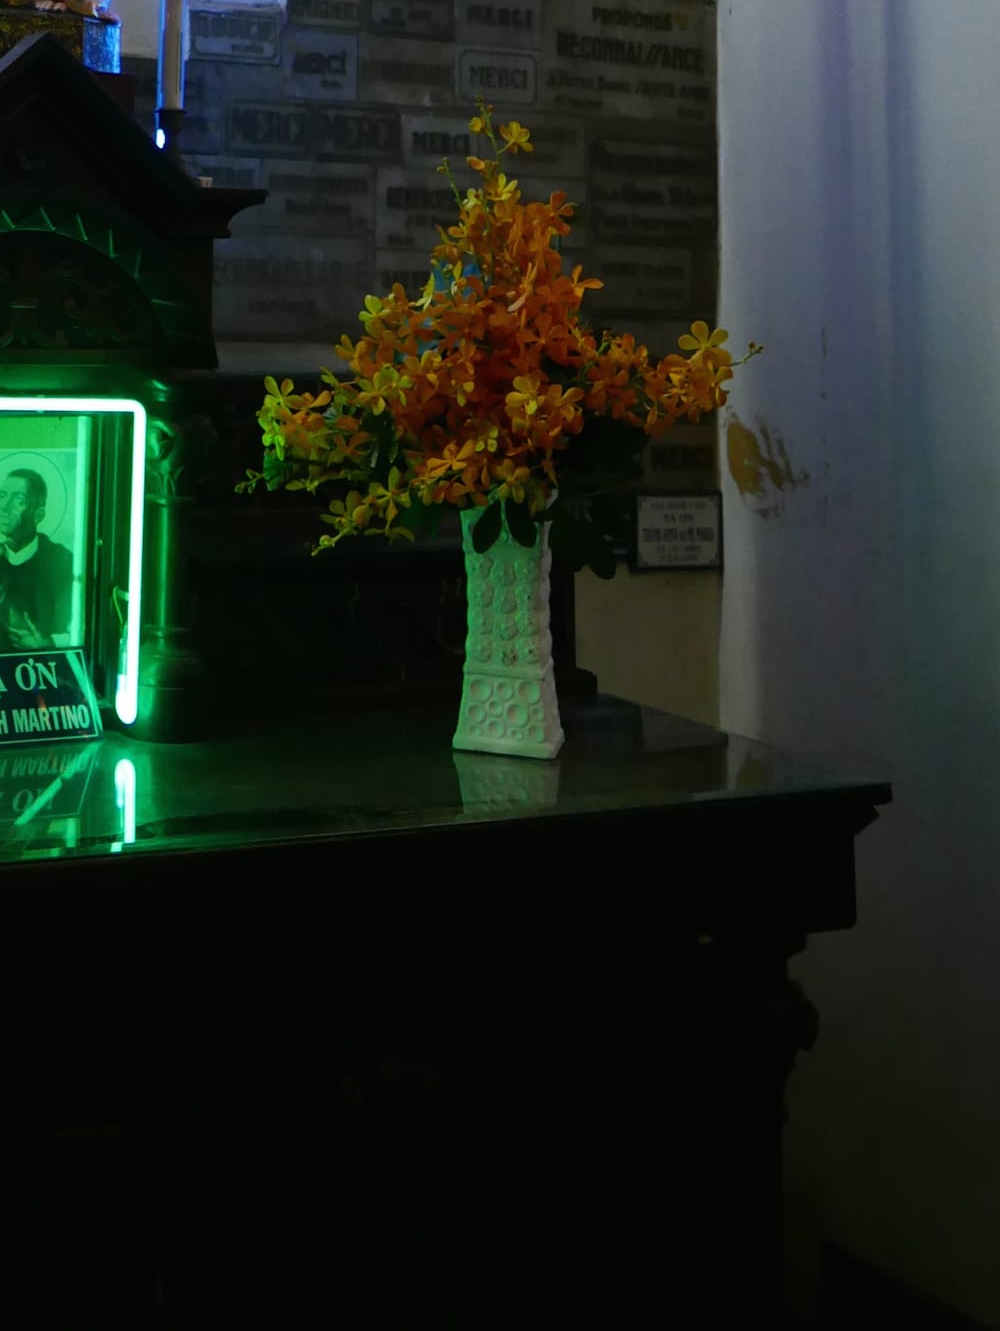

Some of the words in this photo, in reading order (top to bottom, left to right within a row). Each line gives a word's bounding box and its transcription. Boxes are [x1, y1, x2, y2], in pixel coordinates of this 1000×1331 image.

[466, 4, 534, 30] MERCI
[469, 65, 528, 91] MERCI
[15, 657, 60, 692] ƠN
[13, 701, 92, 734] MARTINO
